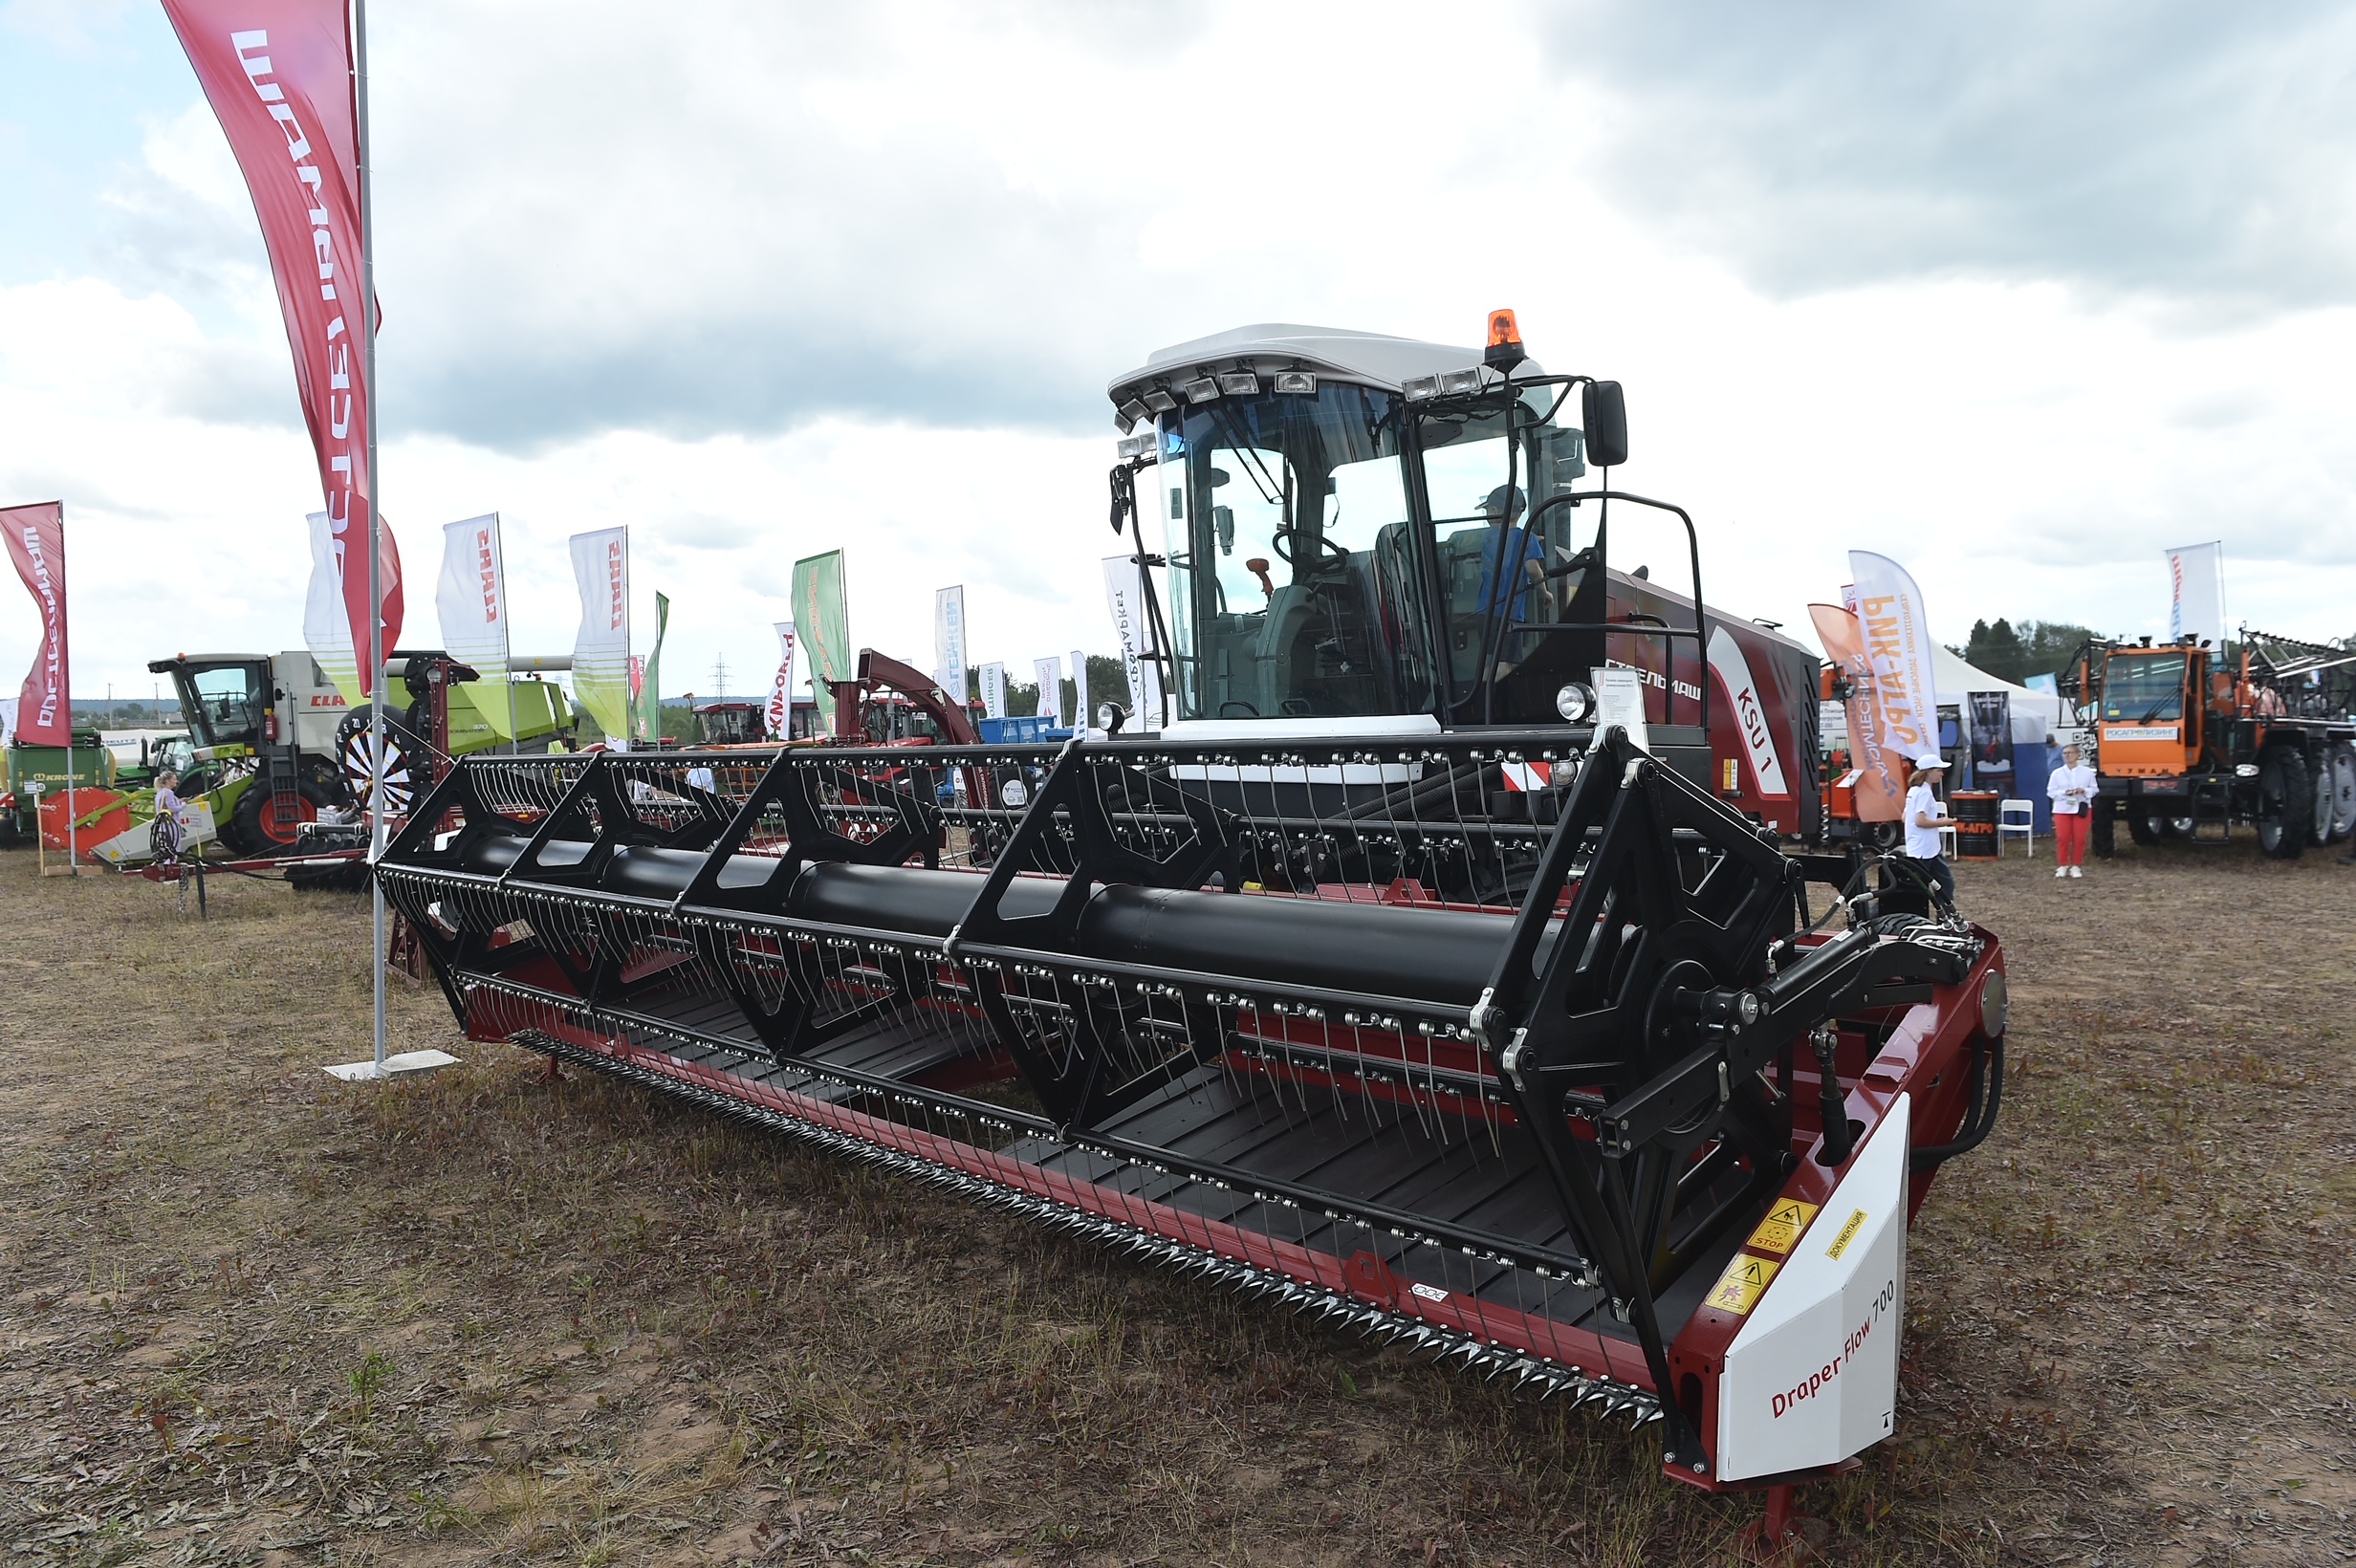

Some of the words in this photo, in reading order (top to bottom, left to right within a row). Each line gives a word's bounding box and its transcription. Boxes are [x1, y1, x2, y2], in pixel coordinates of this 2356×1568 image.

[311, 695, 346, 707] CLA
[343, 723, 349, 733] 5
[1737, 687, 1766, 750] KSU
[1761, 756, 1772, 773] 1
[394, 734, 400, 745] 4
[1954, 821, 1994, 834] ИК-АГРО
[1829, 1210, 1865, 1258] ДОКУМЕНТАЦИЯ
[1756, 1237, 1784, 1250] STOP
[1771, 1356, 1842, 1419] Draper
[1843, 1317, 1870, 1363] Flow
[1872, 1279, 1894, 1323] 700
